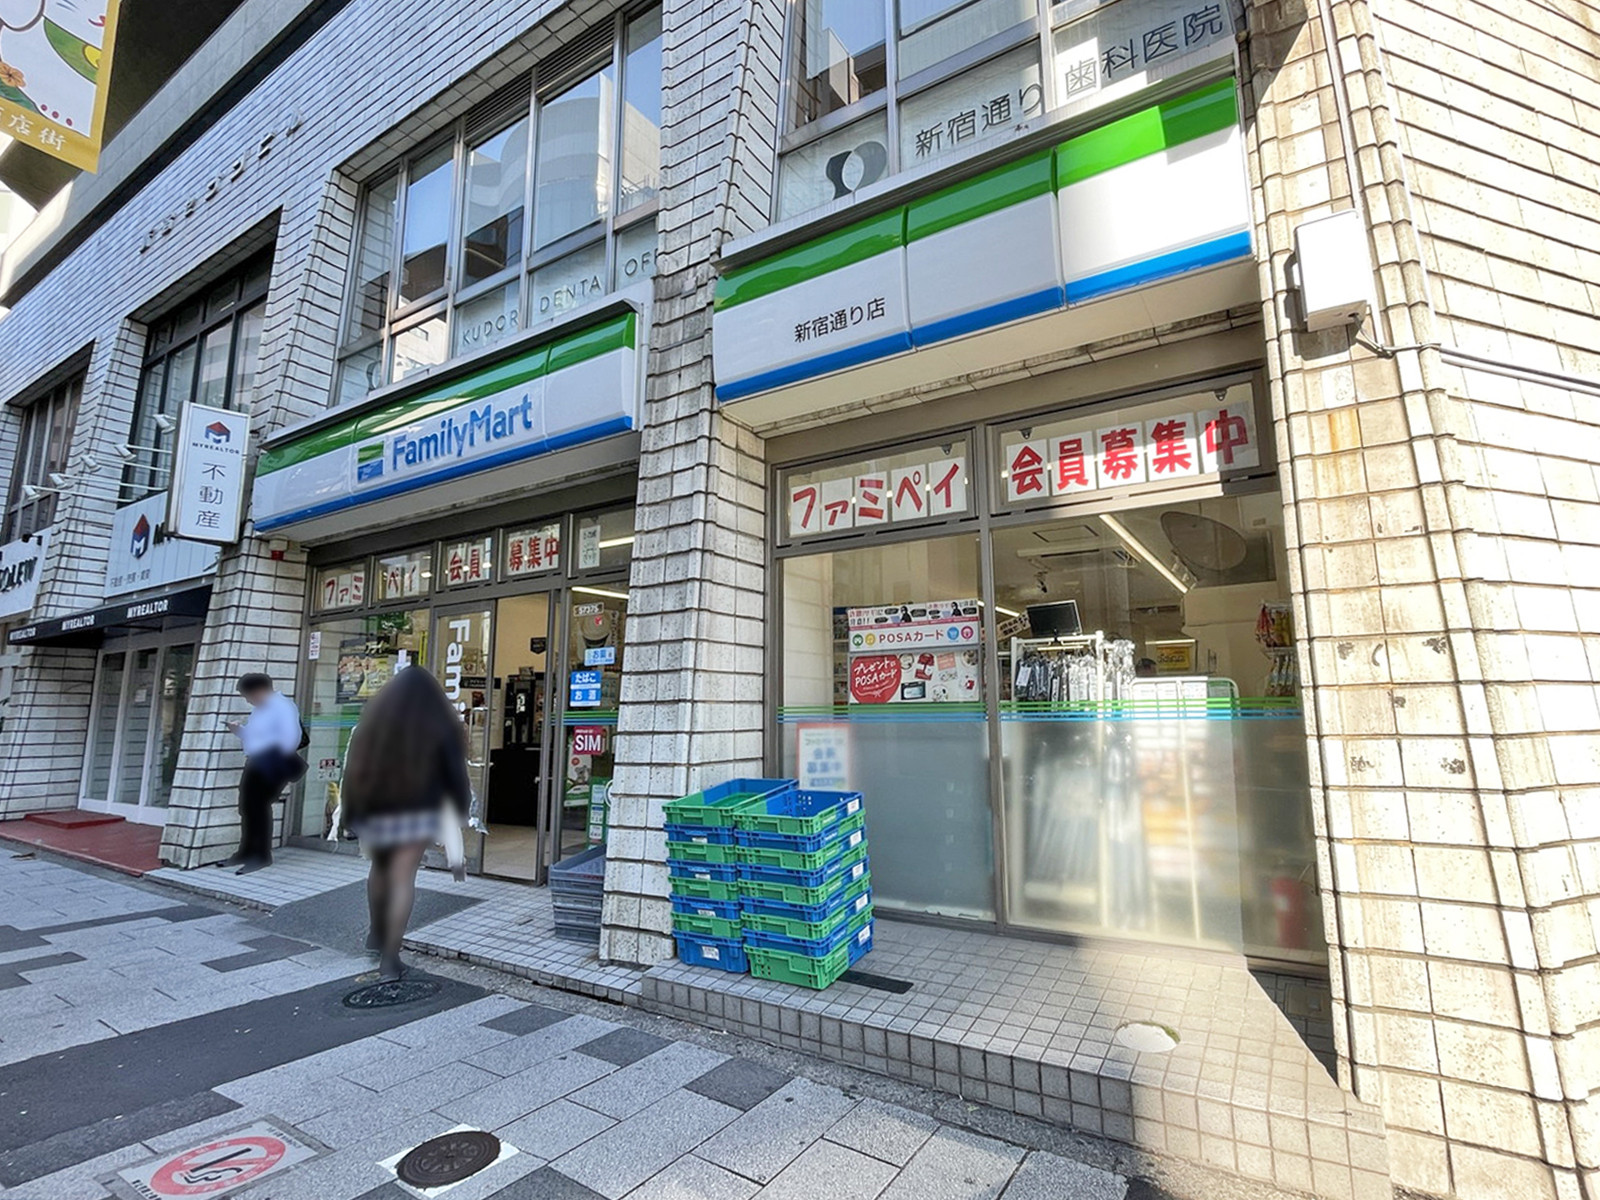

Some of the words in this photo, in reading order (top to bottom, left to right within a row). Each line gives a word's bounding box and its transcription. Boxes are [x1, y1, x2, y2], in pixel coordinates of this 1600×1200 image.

[915, 83, 1042, 157] 新宿通り
[1066, 4, 1223, 96] 歯科医院
[794, 297, 885, 343] 新宿通り店
[192, 441, 240, 455] MYREALTOR
[392, 393, 533, 471] FamilyMart
[792, 463, 960, 529] ファミペイ
[1011, 409, 1249, 495] 会員募集中
[195, 462, 226, 529] 不動産
[325, 575, 364, 605] ファミ
[449, 549, 481, 581] 会員
[509, 532, 559, 571] 募集中
[126, 600, 169, 619] MYREALTOR
[879, 630, 944, 643] POSAカード
[575, 672, 597, 683] たばこ
[575, 734, 601, 752] SIM
